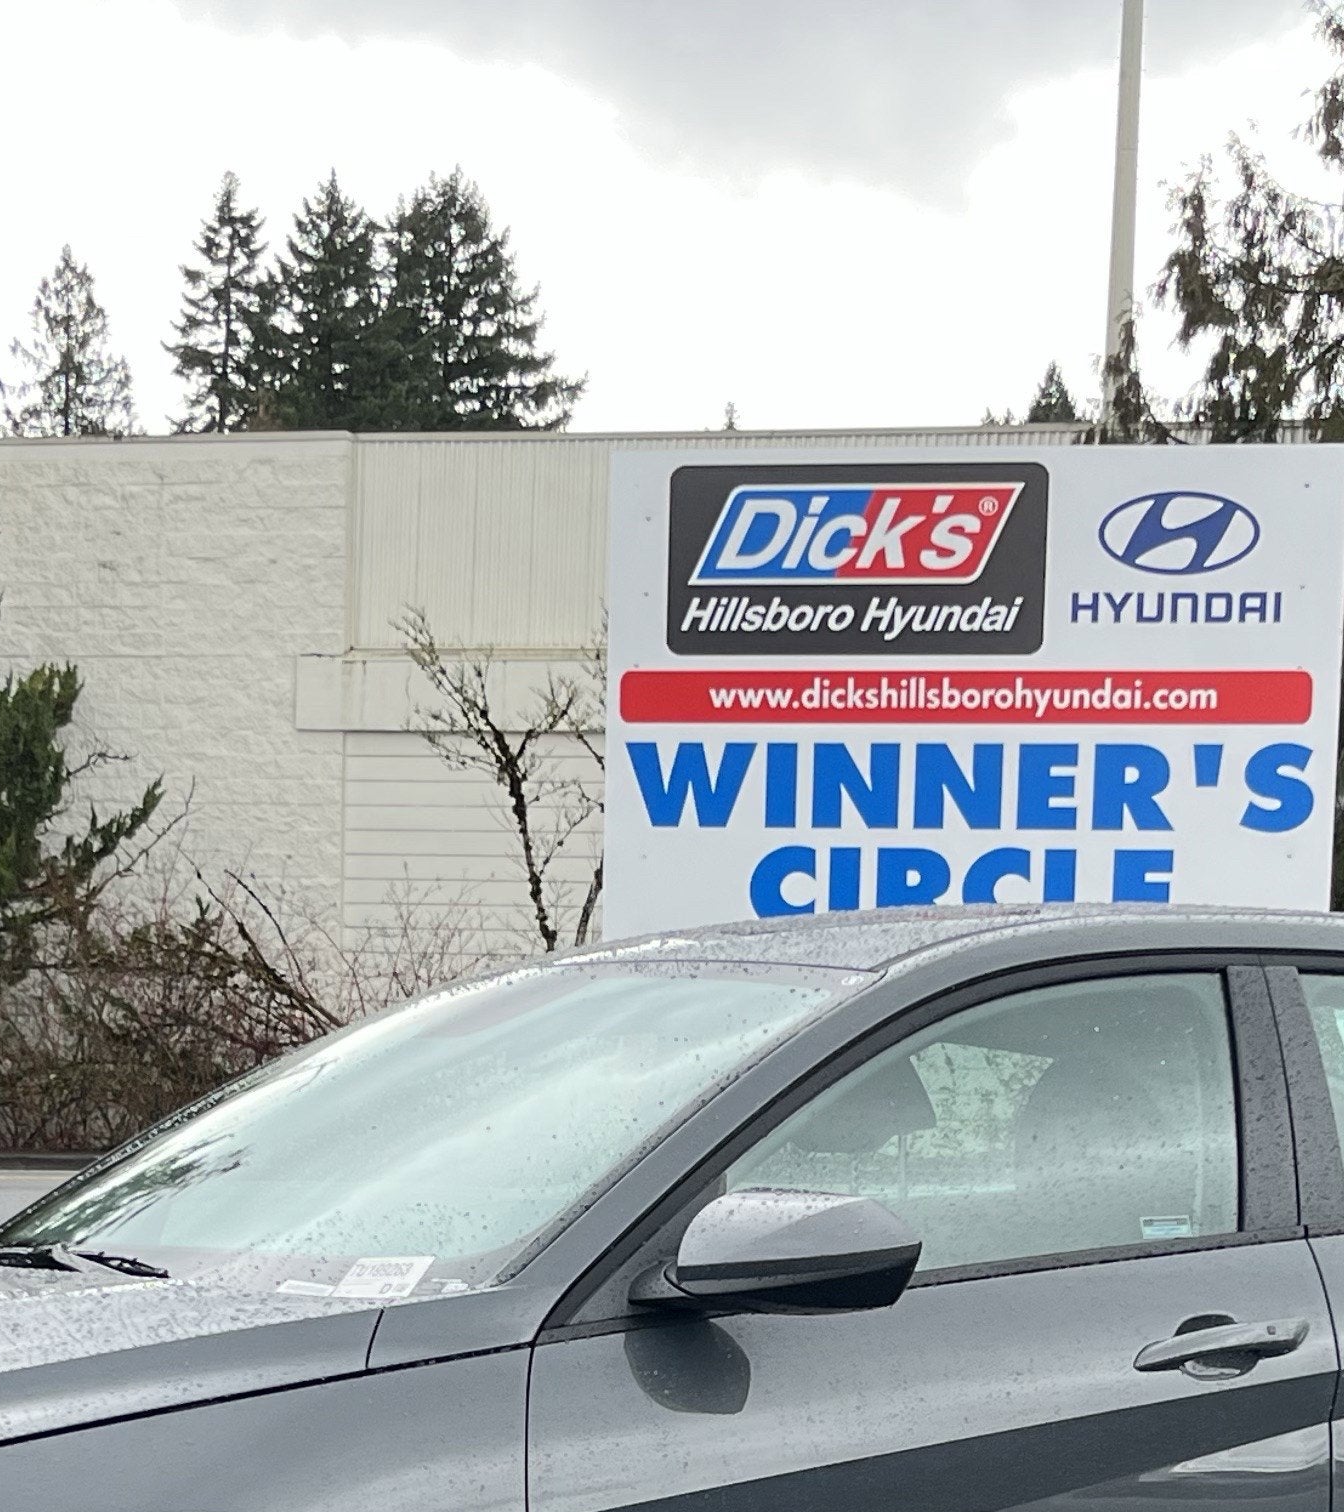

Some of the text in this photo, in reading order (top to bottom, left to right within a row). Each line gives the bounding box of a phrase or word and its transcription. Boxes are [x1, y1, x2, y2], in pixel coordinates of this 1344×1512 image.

[716, 495, 981, 571] Dick's
[681, 596, 1024, 641] Hillsboro Hyundai
[1071, 591, 1282, 624] HYUNDAI
[709, 677, 1218, 717] www.dickshillsborohyundai.com
[626, 741, 1314, 833] WINNER'S
